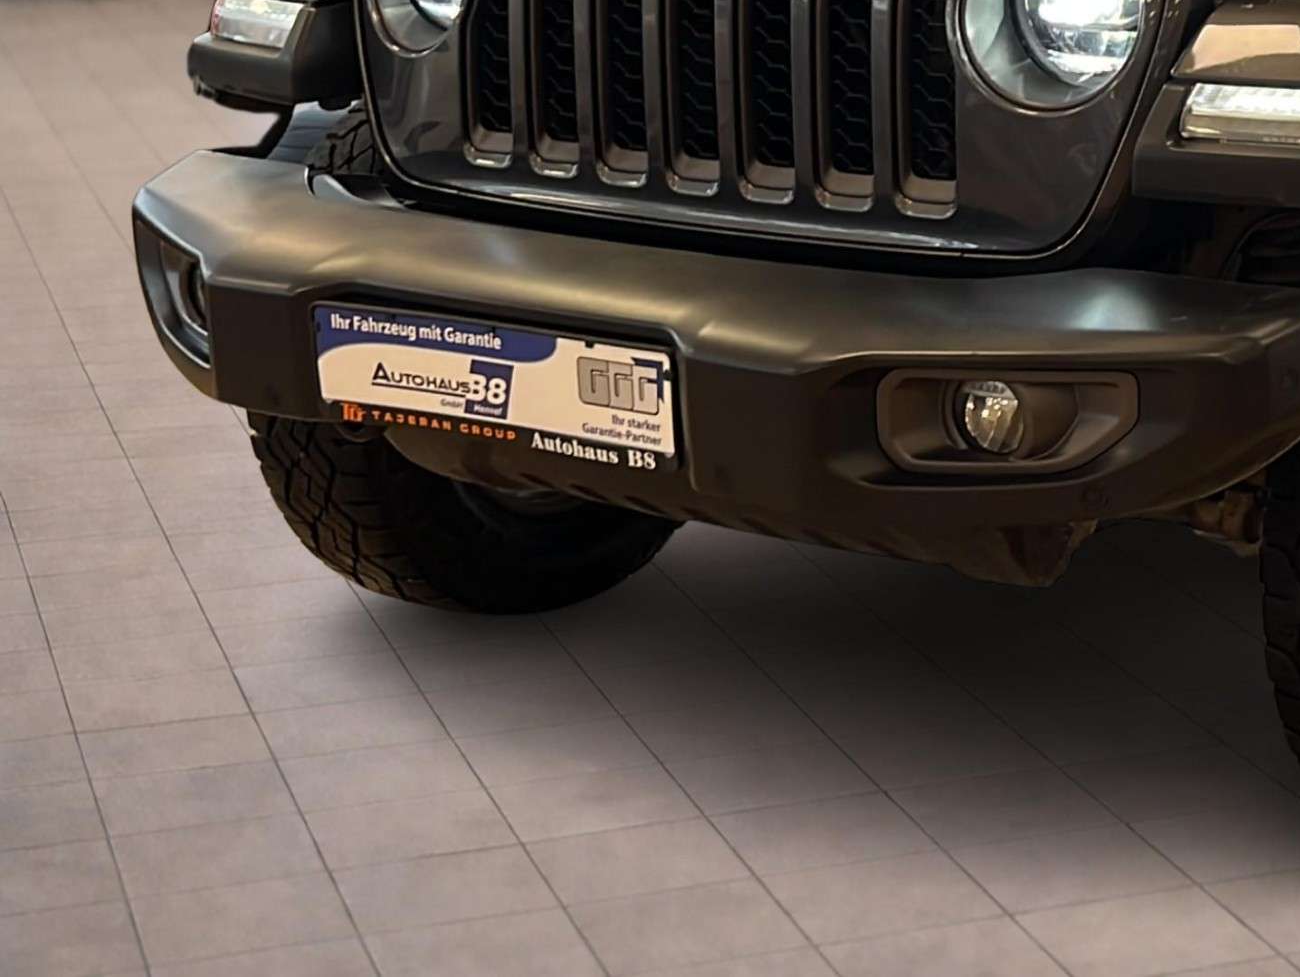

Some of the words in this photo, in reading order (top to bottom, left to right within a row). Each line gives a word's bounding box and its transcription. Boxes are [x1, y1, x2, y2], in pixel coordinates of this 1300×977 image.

[330, 313, 352, 331] Ihr
[353, 315, 417, 341] Fahrzeug
[419, 324, 442, 341] mit
[444, 327, 501, 350] Garantie
[371, 410, 452, 431] TAJERAN
[459, 423, 516, 440] GROUP
[582, 422, 662, 446] Garantie-Partner
[611, 414, 625, 426] Ihr
[627, 417, 661, 433] starker
[531, 431, 619, 465] Autohaus
[627, 449, 656, 470] B8
